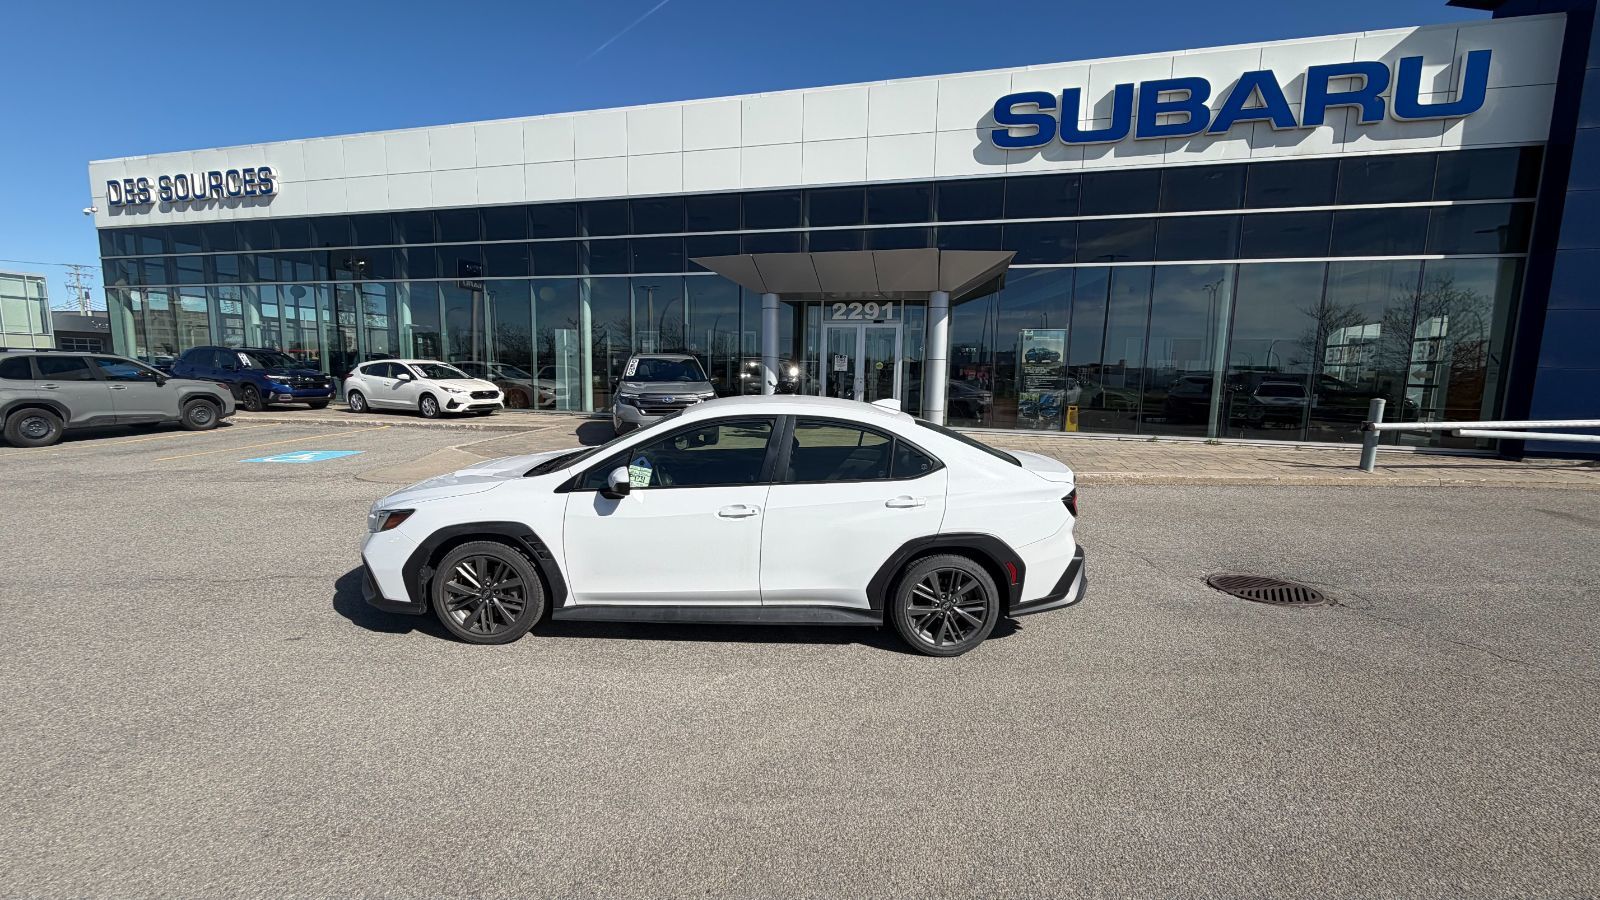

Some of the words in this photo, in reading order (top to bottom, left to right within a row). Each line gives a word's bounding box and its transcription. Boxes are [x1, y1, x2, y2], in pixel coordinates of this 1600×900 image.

[991, 49, 1492, 149] SUBARU
[107, 177, 151, 205] DES
[159, 166, 275, 202] SOURCES
[831, 301, 893, 320] 2291
